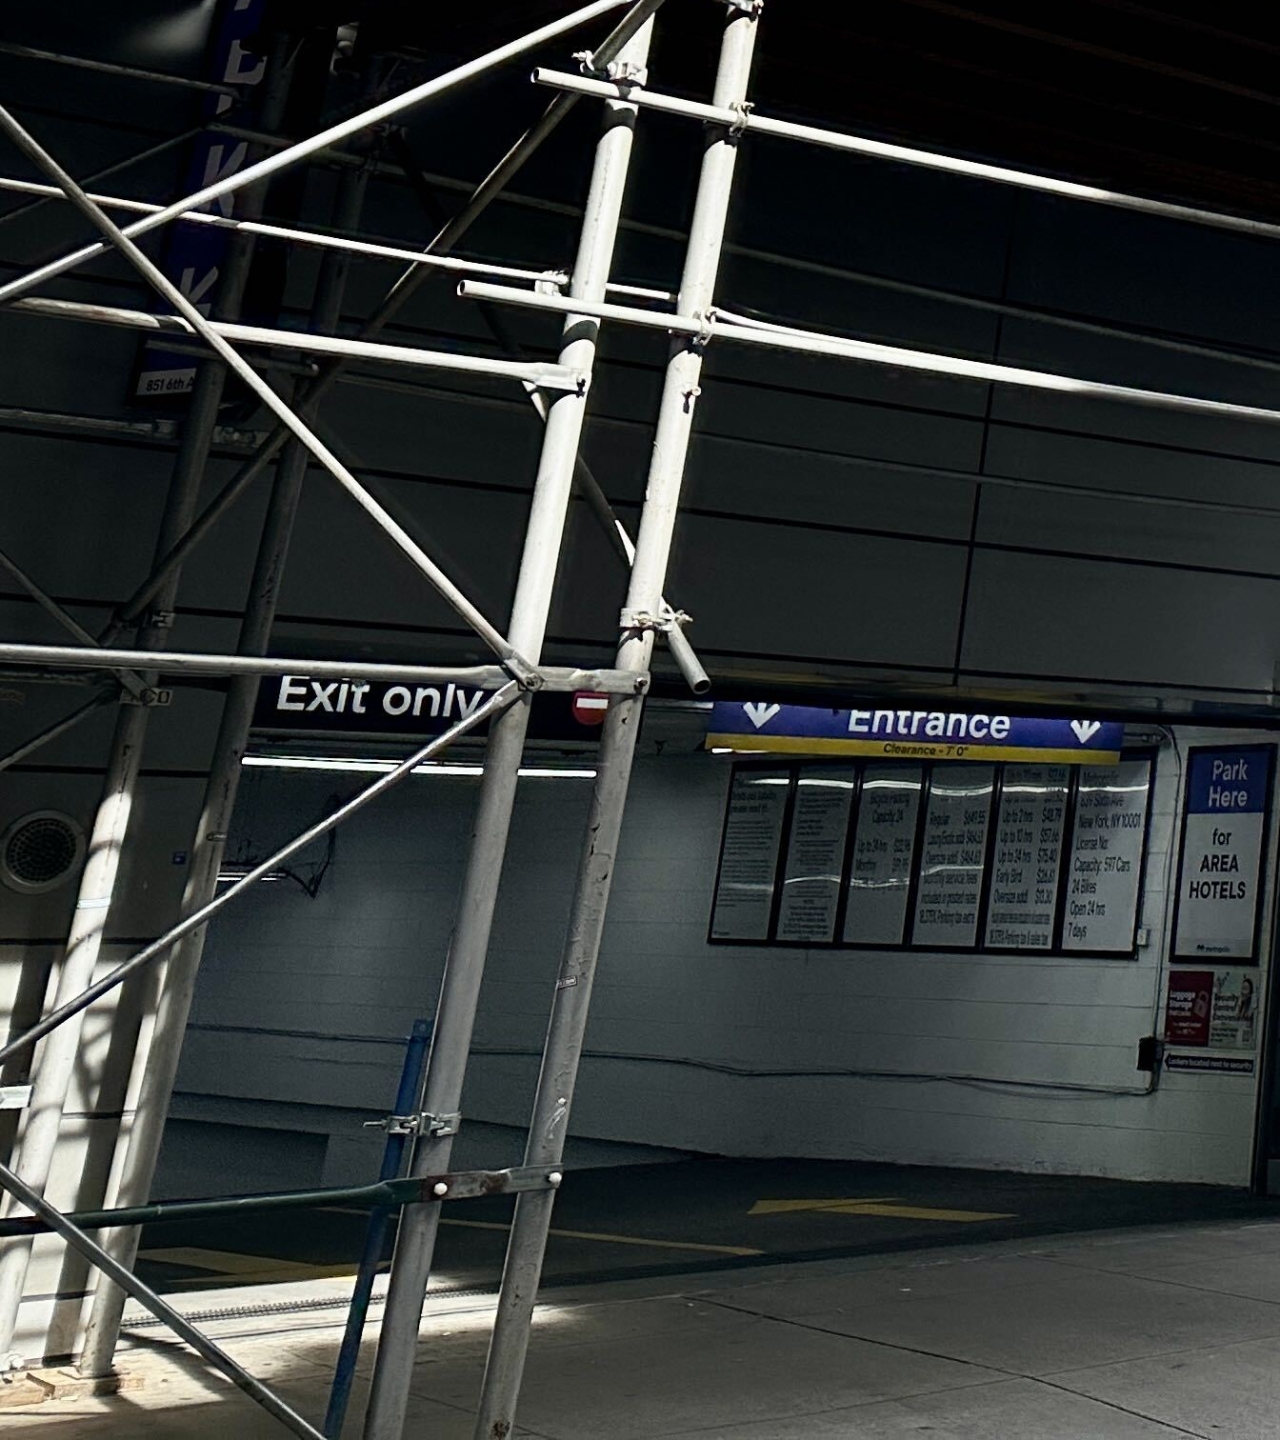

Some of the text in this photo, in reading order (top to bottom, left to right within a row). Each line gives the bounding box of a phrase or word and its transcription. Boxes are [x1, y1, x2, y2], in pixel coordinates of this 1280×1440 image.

[166, 377, 184, 390] 6th
[276, 675, 484, 726] Exit only
[848, 710, 1011, 739] Entrance
[884, 743, 936, 756] Clearance
[1212, 759, 1249, 782] Park
[1208, 786, 1247, 807] Here
[1078, 813, 1094, 829] New
[1110, 813, 1121, 828] NY
[1212, 827, 1232, 846] for
[1199, 854, 1239, 873] AREA
[1189, 880, 1246, 900] HOTELS
[1069, 901, 1106, 917] Open 24 hrs
